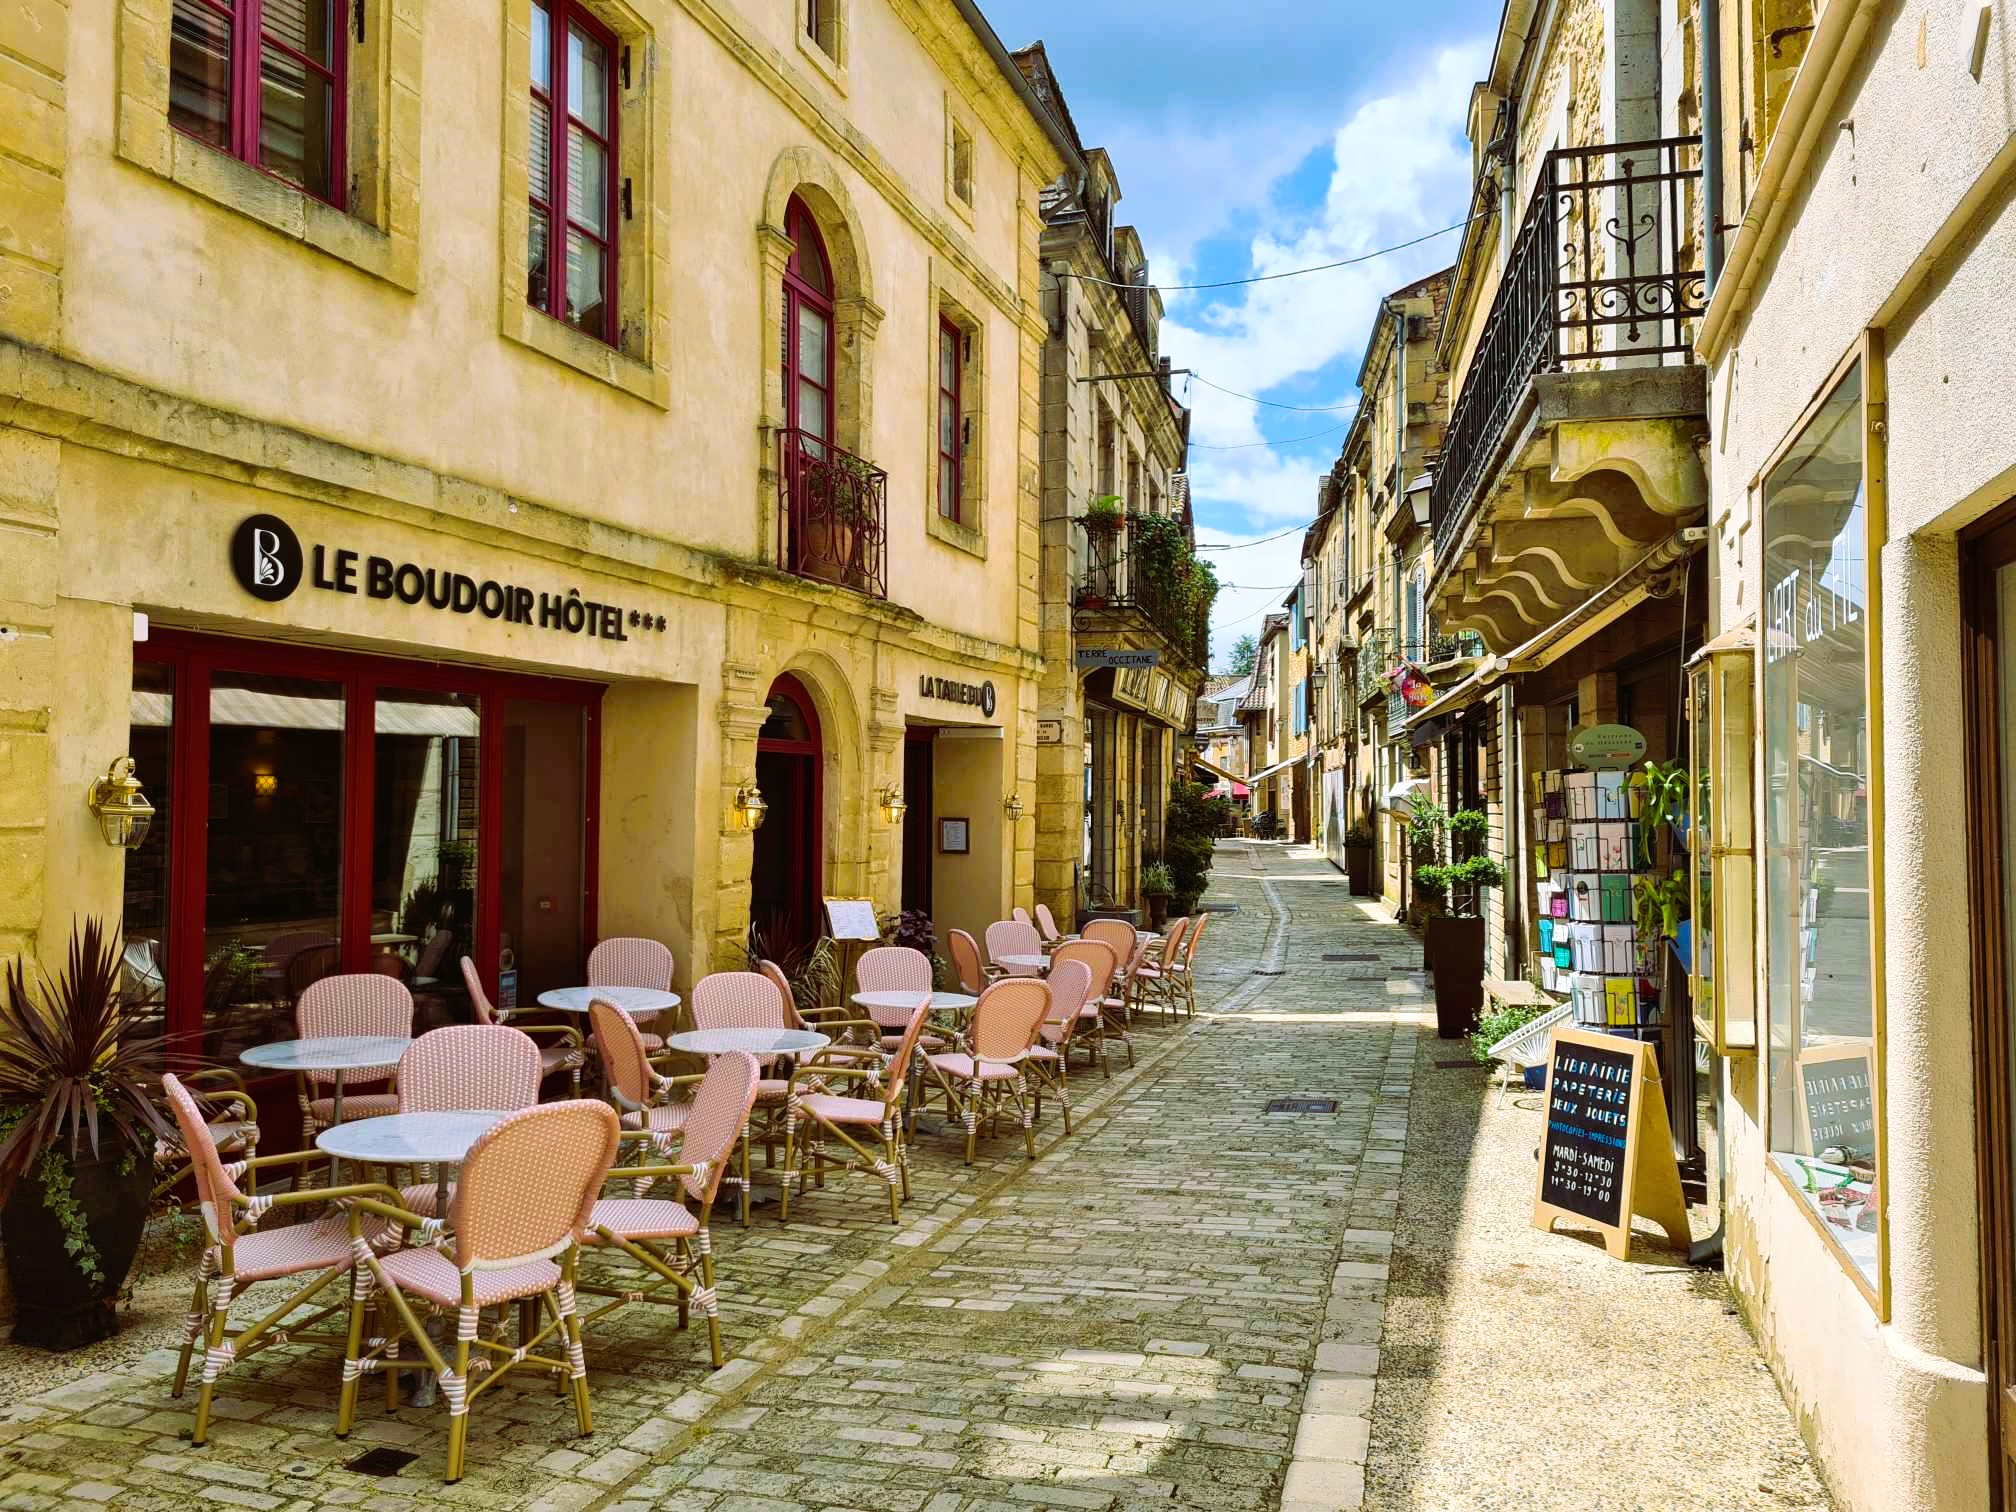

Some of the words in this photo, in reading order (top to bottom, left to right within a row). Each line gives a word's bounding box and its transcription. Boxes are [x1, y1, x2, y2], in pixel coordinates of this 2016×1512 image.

[255, 527, 285, 587] B
[313, 544, 359, 594] LE
[367, 555, 535, 626] BOUDOIR
[540, 587, 628, 642] HÔTEL
[1805, 559, 1824, 642] du
[1832, 526, 1858, 631] FIL
[1078, 649, 1109, 659] TERRE
[1108, 655, 1153, 665] OCCITANE
[919, 674, 934, 699] LA
[934, 677, 967, 705] TABLE
[1553, 1077, 1627, 1105] PAPETERIE
[1552, 1095, 1578, 1115] JEUX
[1586, 1102, 1627, 1127] JOUETS
